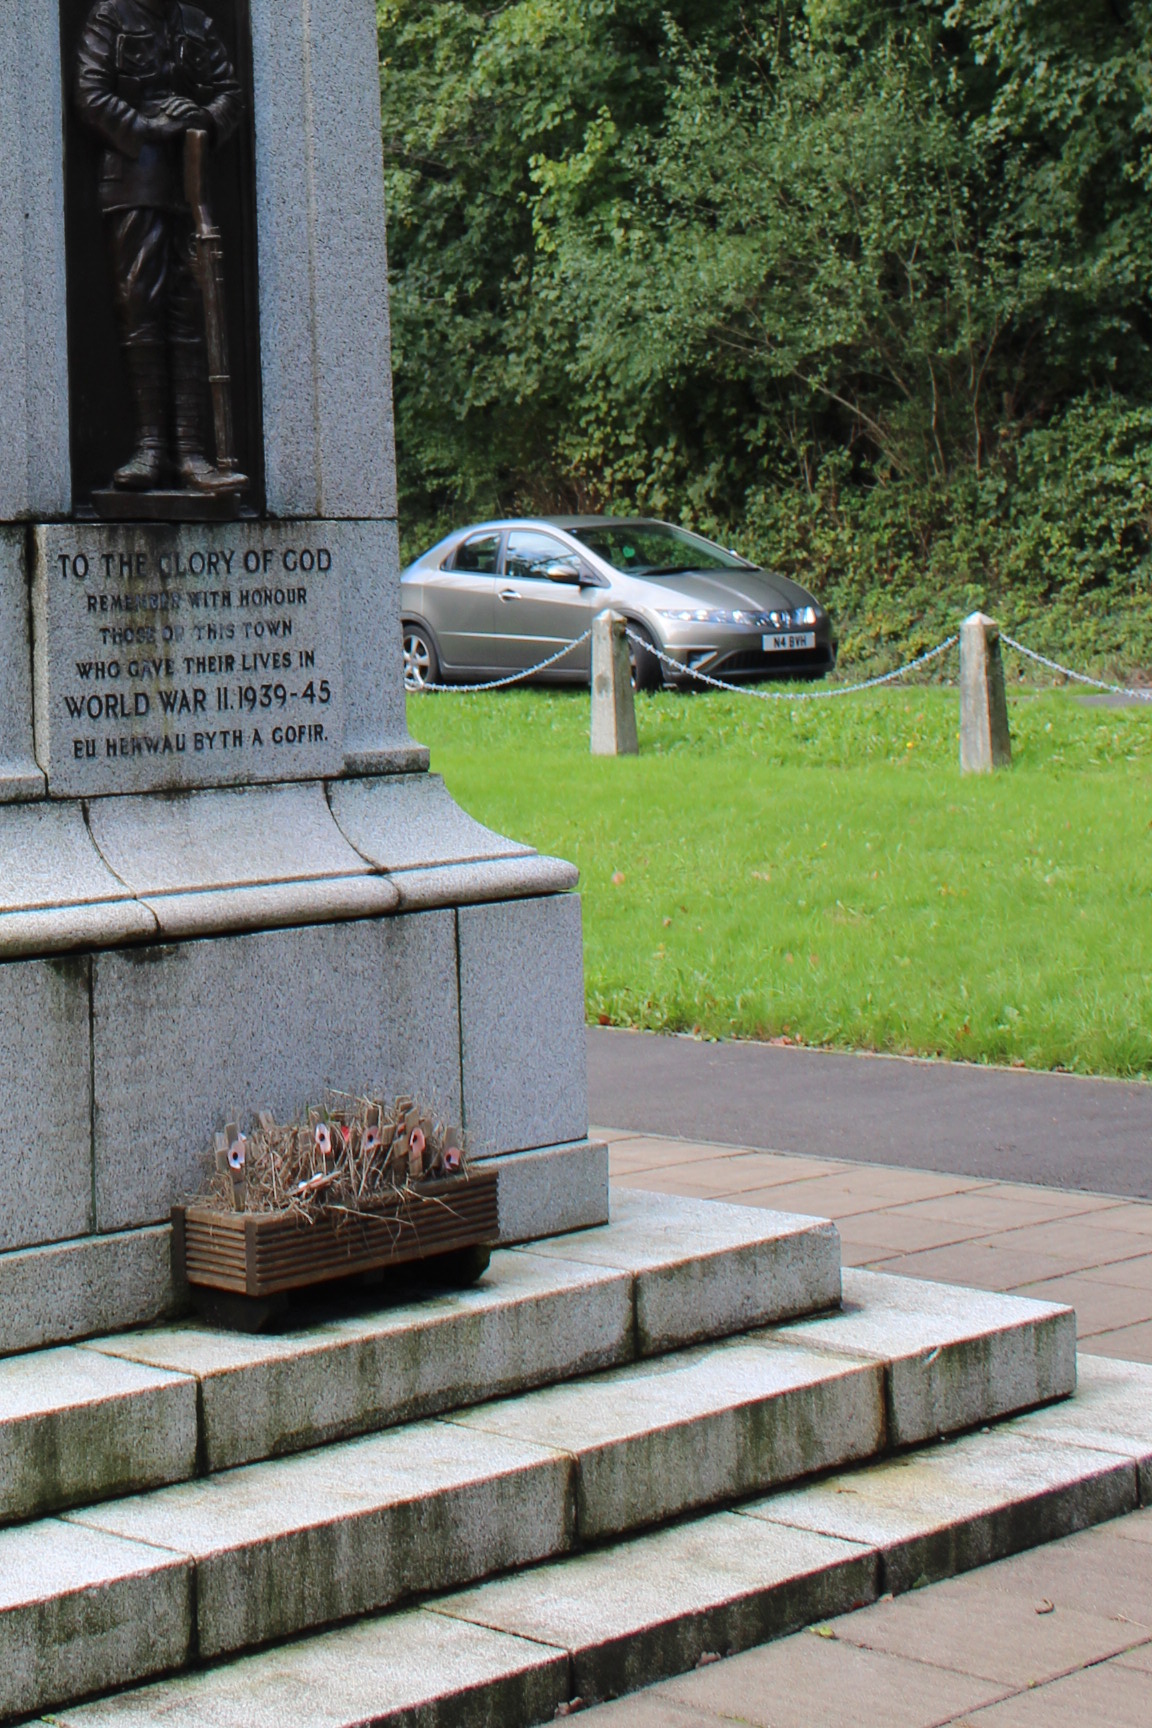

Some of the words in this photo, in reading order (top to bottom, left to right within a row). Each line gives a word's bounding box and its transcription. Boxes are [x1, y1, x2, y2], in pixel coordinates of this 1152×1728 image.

[57, 553, 90, 577] TO
[101, 553, 148, 577] THE
[159, 550, 235, 577] GLORY
[243, 549, 273, 572] OF
[282, 548, 332, 572] GOD
[186, 591, 231, 610] WITH
[239, 588, 307, 608] HONOUR
[99, 626, 155, 644] THOSE
[162, 625, 184, 643] OF
[195, 623, 235, 641] THIS
[242, 620, 293, 638] TOWN
[773, 636, 786, 648] N4
[76, 661, 120, 680] WHO
[128, 657, 174, 679] GAVE
[184, 654, 234, 674] THEIR
[241, 652, 292, 672] LIVES
[299, 650, 315, 668] IN
[65, 692, 149, 719] WORLD
[158, 689, 207, 714] WAR
[74, 740, 95, 759] EU
[194, 729, 243, 752] BYTH
[252, 729, 263, 746] A
[272, 724, 329, 744] GOFIR.
